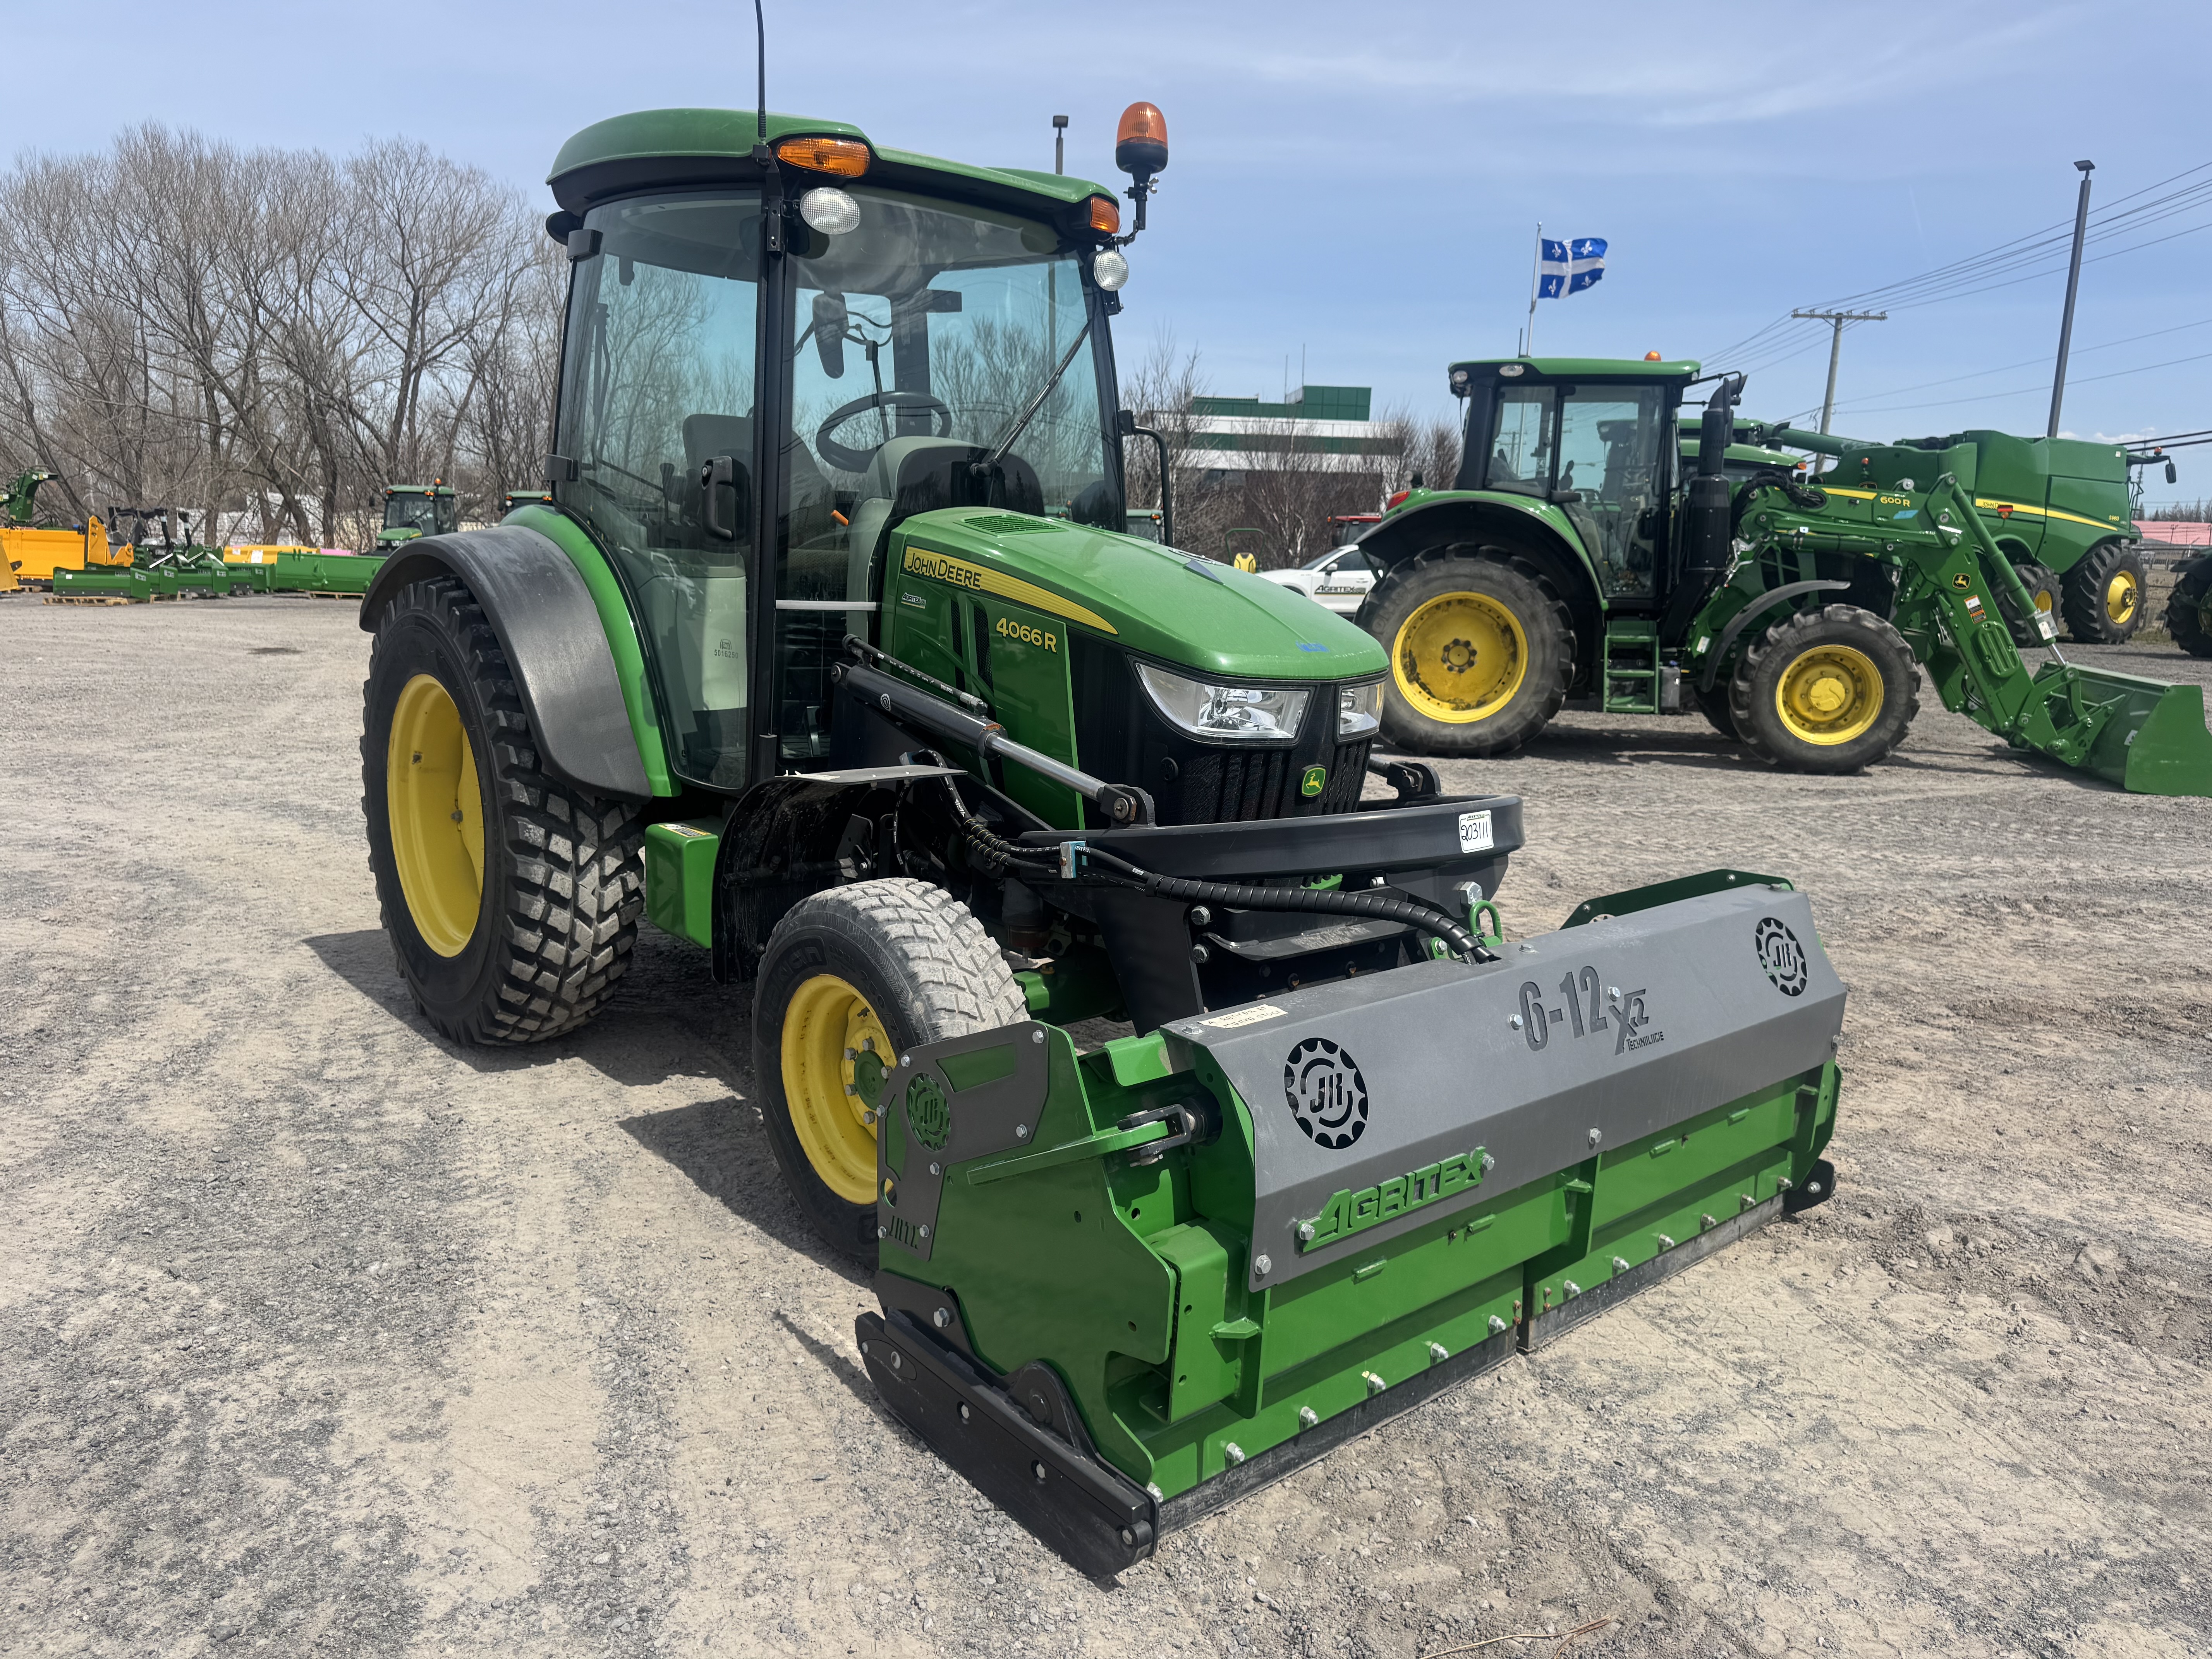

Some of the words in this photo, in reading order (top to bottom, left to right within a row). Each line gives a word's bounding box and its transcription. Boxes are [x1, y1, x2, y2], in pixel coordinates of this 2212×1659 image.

[907, 553, 937, 576] JOHN
[938, 559, 982, 588] DEERE
[1315, 585, 1355, 593] AGRITEX
[714, 649, 738, 659] 5016250
[1461, 821, 1489, 842] 203111
[1256, 1010, 1281, 1019] STOCK
[1519, 966, 1608, 1051] 6-12
[1299, 1146, 1486, 1253] AGRITEX
